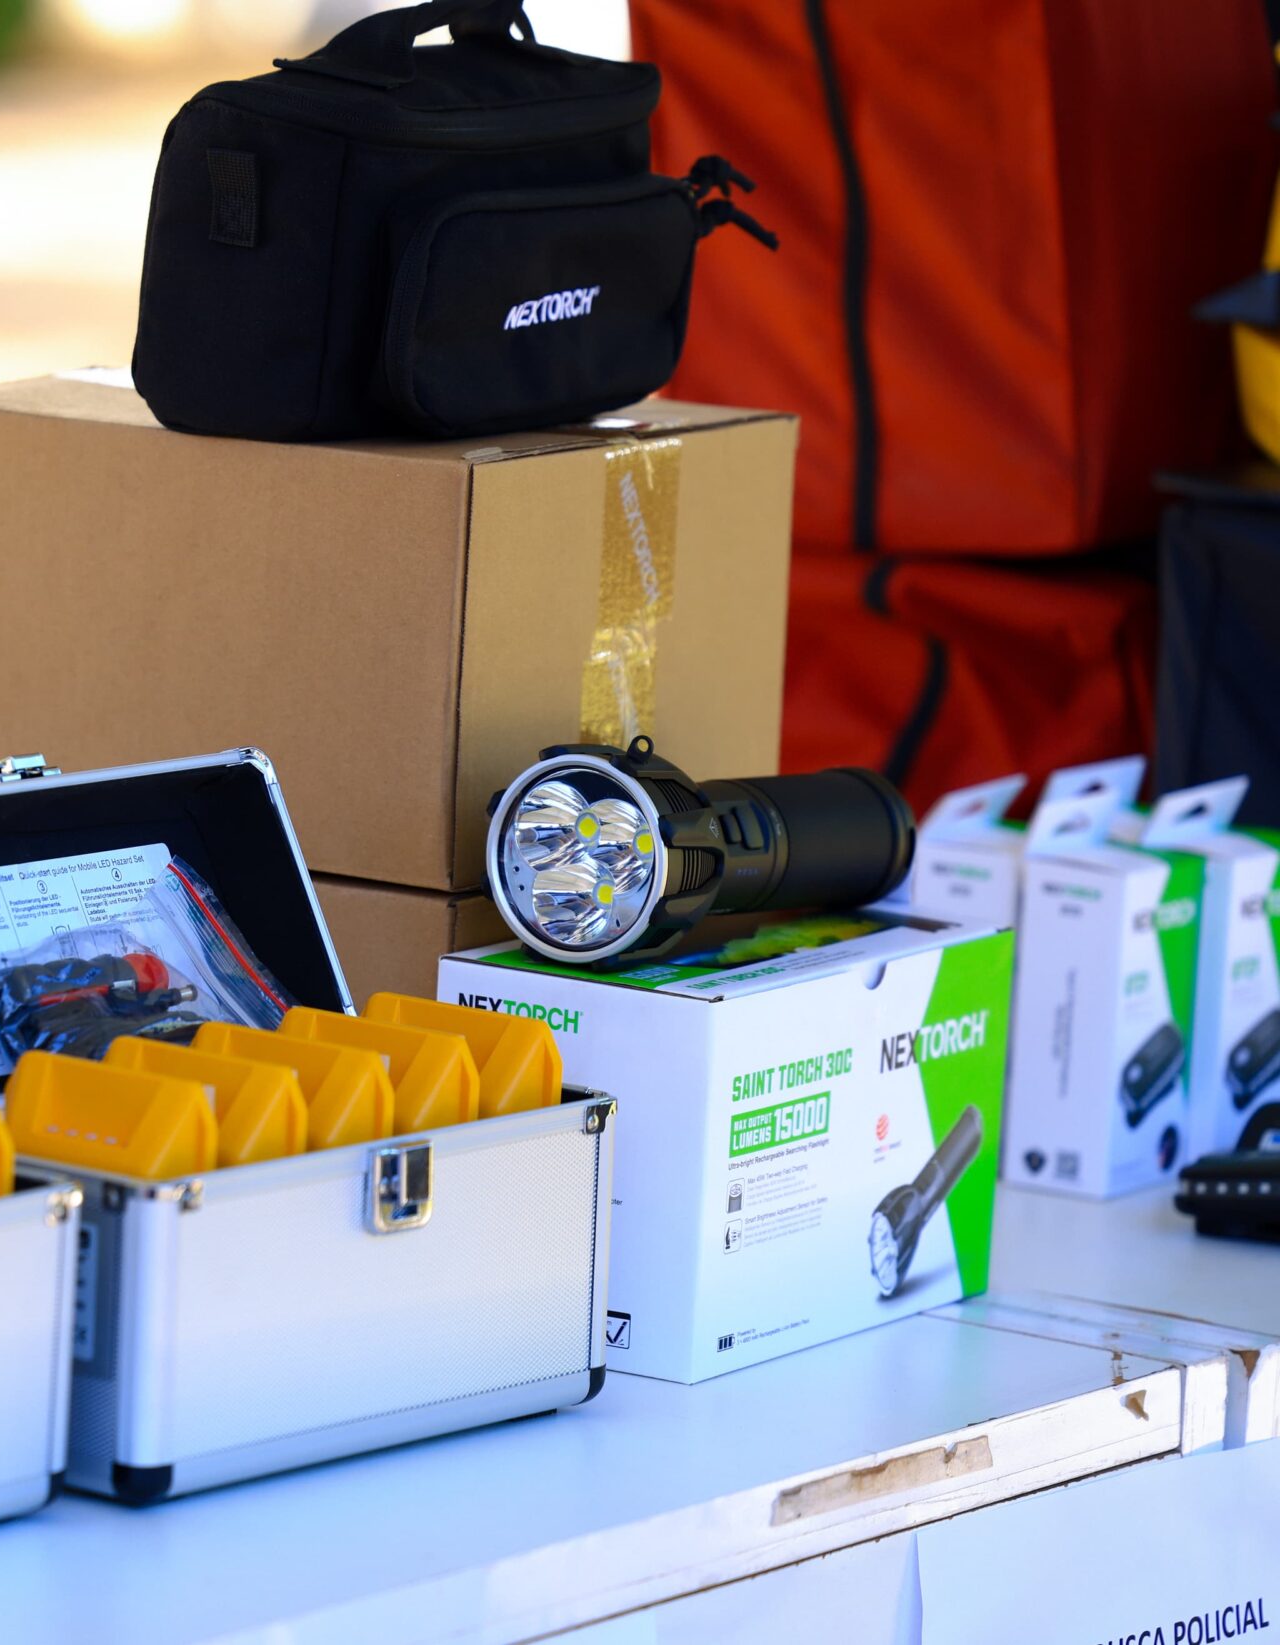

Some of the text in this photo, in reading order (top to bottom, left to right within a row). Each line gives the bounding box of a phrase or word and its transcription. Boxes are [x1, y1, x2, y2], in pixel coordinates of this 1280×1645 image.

[504, 287, 595, 329] NEXTORCH
[19, 854, 144, 880] Quick-start guide for Mobile LED Hazard Set
[880, 1010, 986, 1074] NEXTORCH
[732, 1047, 853, 1102] SAINT TORCH 30C
[733, 1125, 772, 1151] LUMENS
[748, 1112, 773, 1129] OUTPUT
[774, 1096, 828, 1143] 15000
[1174, 1598, 1269, 1645] POLICIAL
